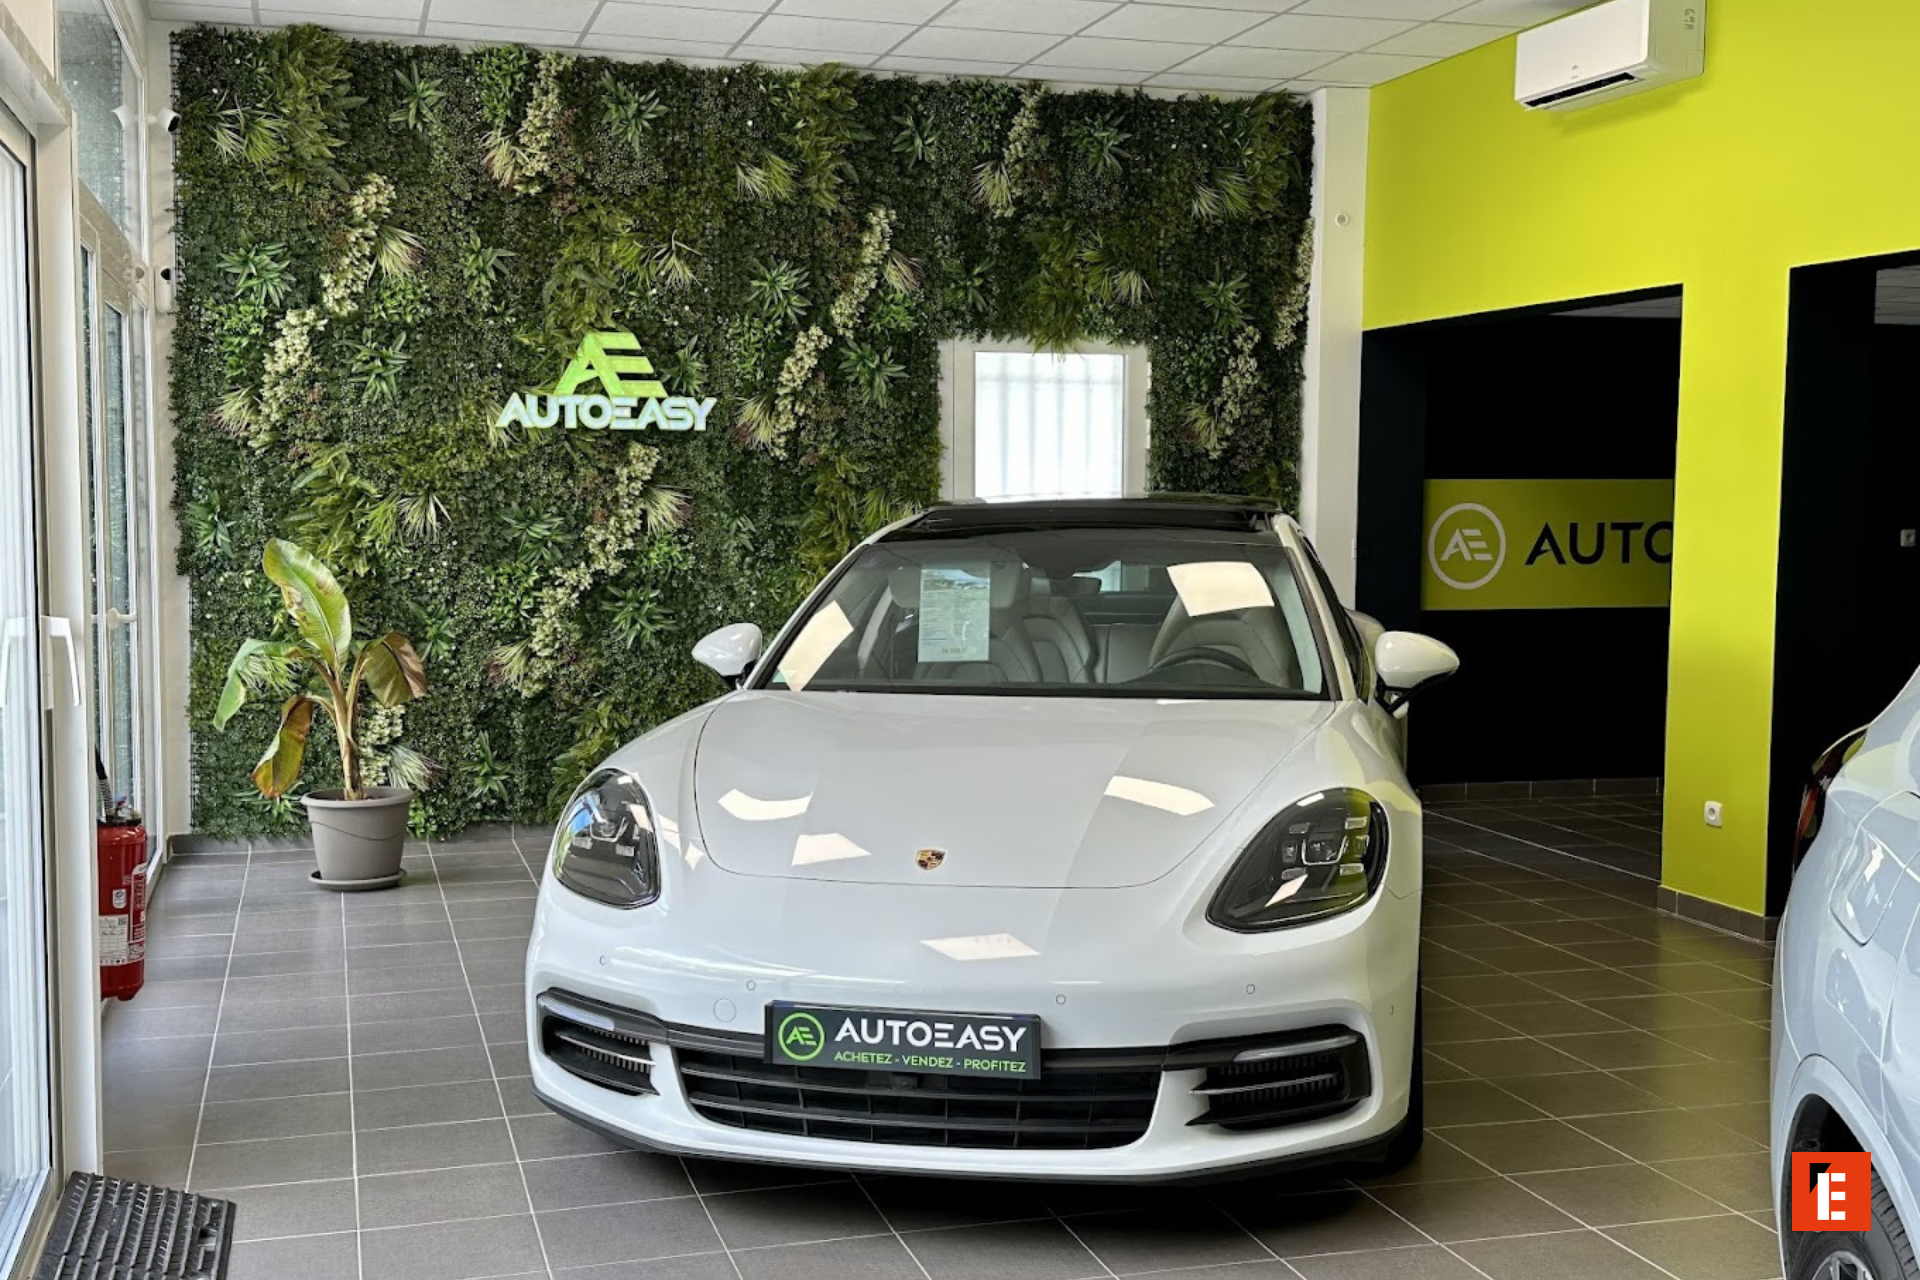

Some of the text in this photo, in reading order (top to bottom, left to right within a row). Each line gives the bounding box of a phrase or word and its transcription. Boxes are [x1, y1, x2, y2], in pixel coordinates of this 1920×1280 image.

[495, 391, 718, 431] AUTOEASY
[1440, 521, 1673, 566] AE AUTO
[785, 1016, 1027, 1052] AE AUTOEASY
[834, 1051, 892, 1064] ACHETEZ
[901, 1054, 954, 1068] VENDEZ
[963, 1058, 1026, 1072] PROFITEZ
